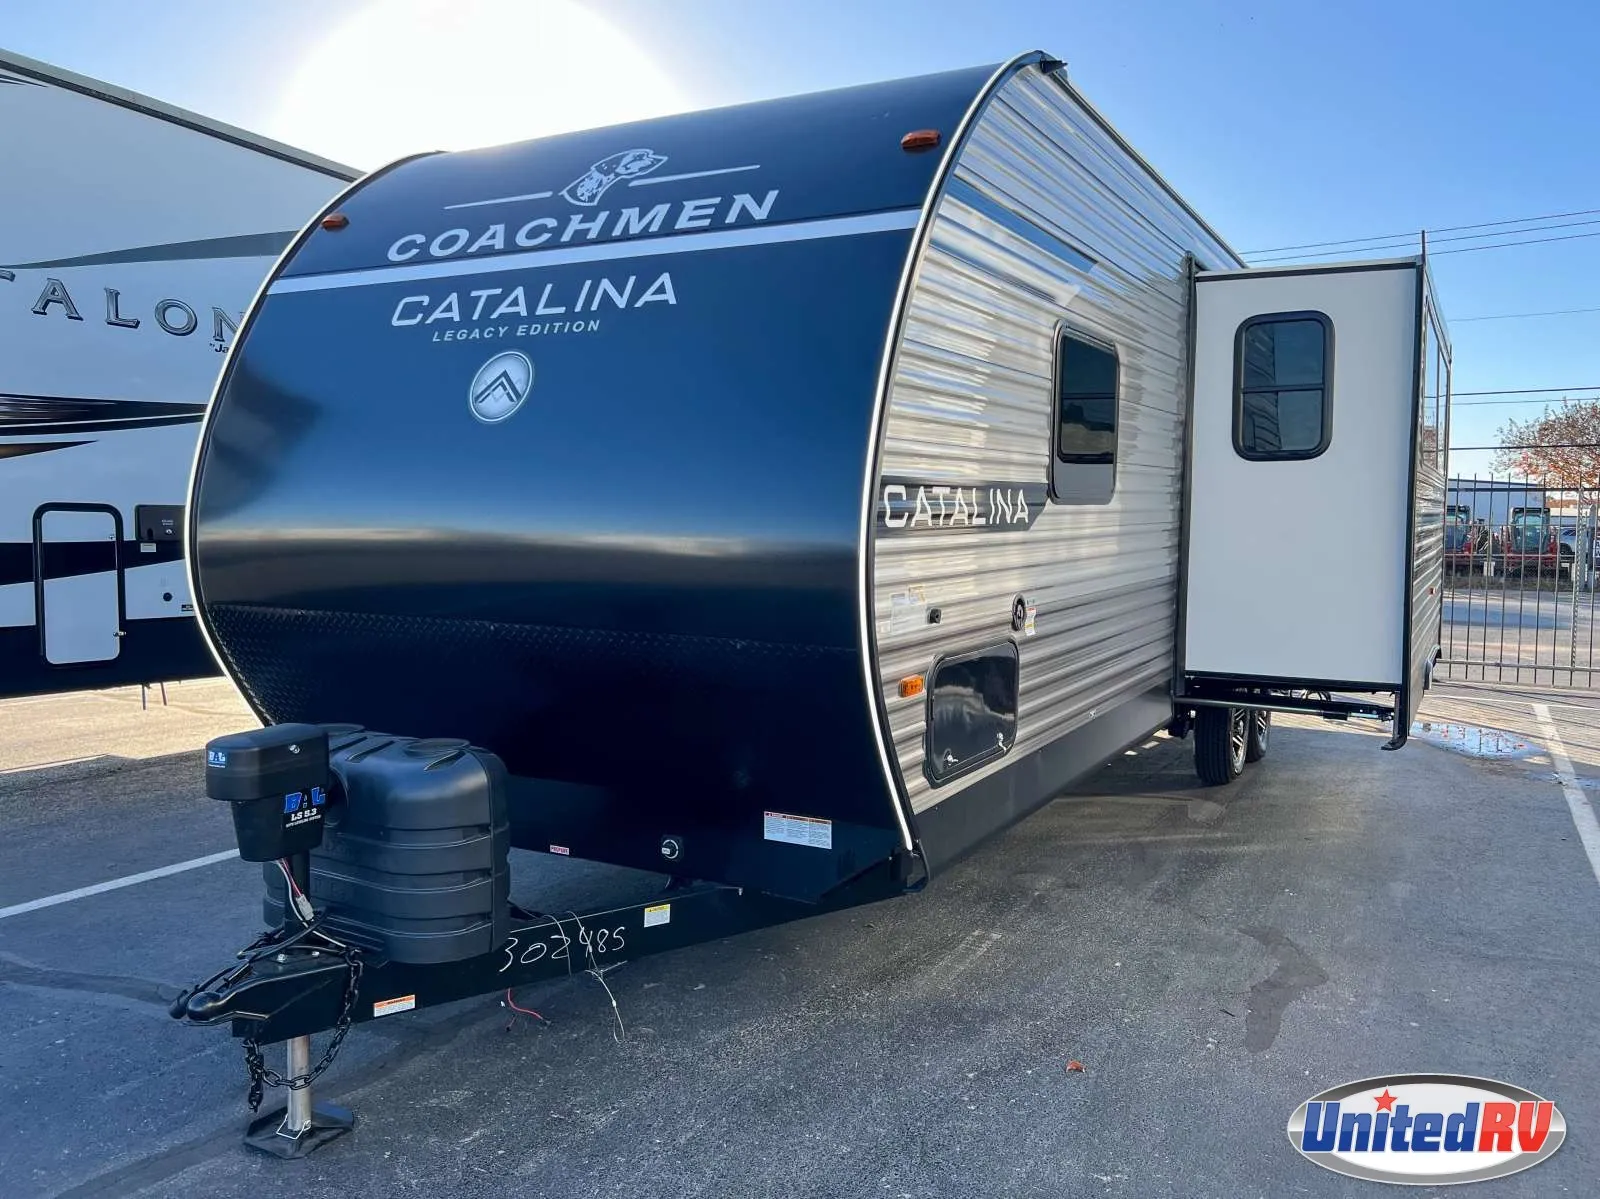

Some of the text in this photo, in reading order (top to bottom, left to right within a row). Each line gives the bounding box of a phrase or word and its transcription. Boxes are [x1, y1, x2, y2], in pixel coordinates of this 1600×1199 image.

[387, 190, 779, 262] COACHMEN
[0, 269, 246, 342] ALON
[391, 272, 677, 326] CATALINA
[432, 319, 600, 342] LEGACY EDITION
[883, 484, 1029, 528] CATALINA
[291, 811, 303, 822] LS
